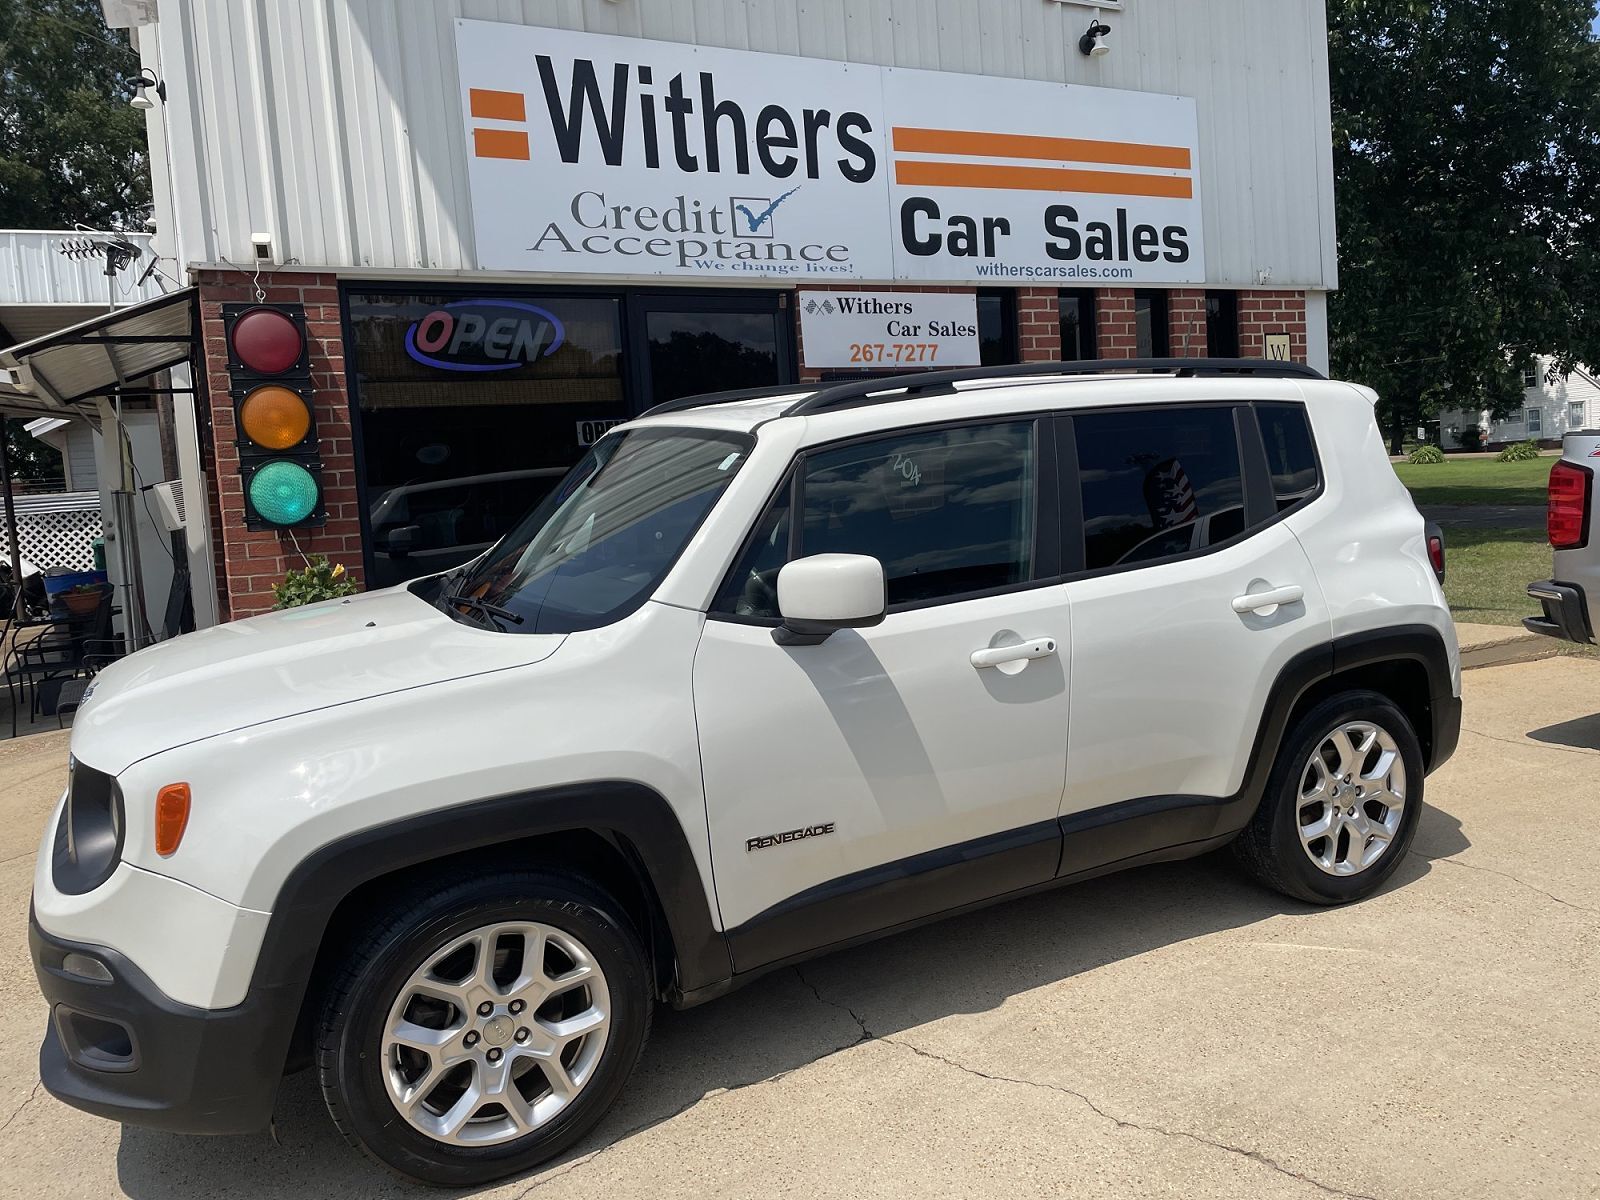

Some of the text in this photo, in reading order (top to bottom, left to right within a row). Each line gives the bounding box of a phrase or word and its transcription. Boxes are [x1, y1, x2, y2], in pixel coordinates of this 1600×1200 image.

[534, 54, 876, 184] Withers
[571, 191, 726, 234] Credit
[900, 196, 1190, 263] Car Sales
[525, 221, 849, 268] Acceptance
[694, 259, 853, 275] We change lives!
[976, 262, 1133, 278] witherscarsales.com
[836, 297, 913, 314] Withers
[416, 310, 548, 362] OPEN
[886, 321, 976, 337] Car Sales
[850, 343, 938, 362] 267-7277
[1270, 344, 1286, 360] W
[745, 822, 835, 851] RENEGADE
